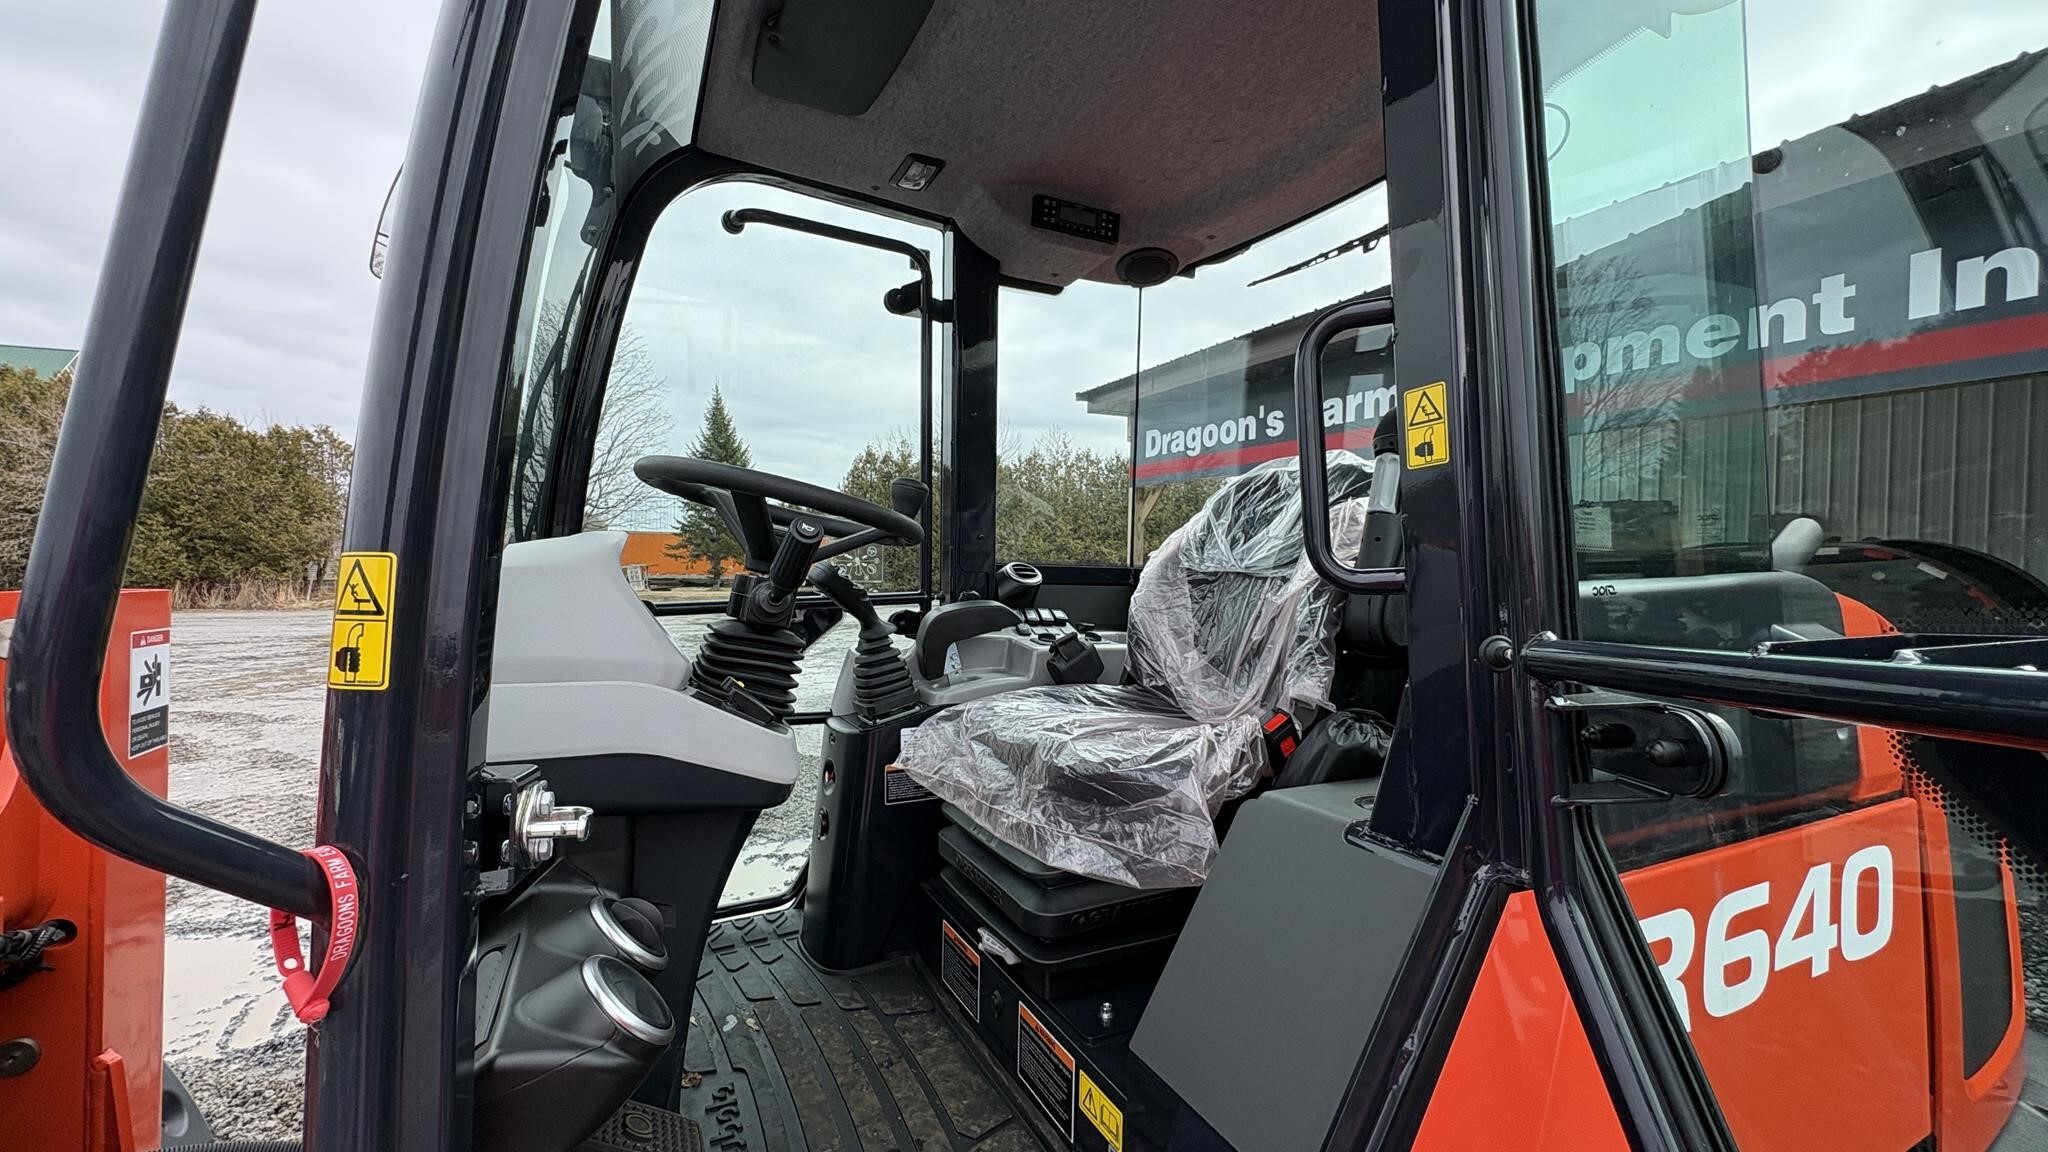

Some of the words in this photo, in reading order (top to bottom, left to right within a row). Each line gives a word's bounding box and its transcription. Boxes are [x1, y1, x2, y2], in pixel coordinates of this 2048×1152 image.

[1145, 405, 1285, 458] Dragoon's
[1322, 384, 1398, 428] arm
[1562, 273, 1856, 394] pment
[327, 857, 353, 890] FARM
[330, 893, 355, 962] DRAGOONS
